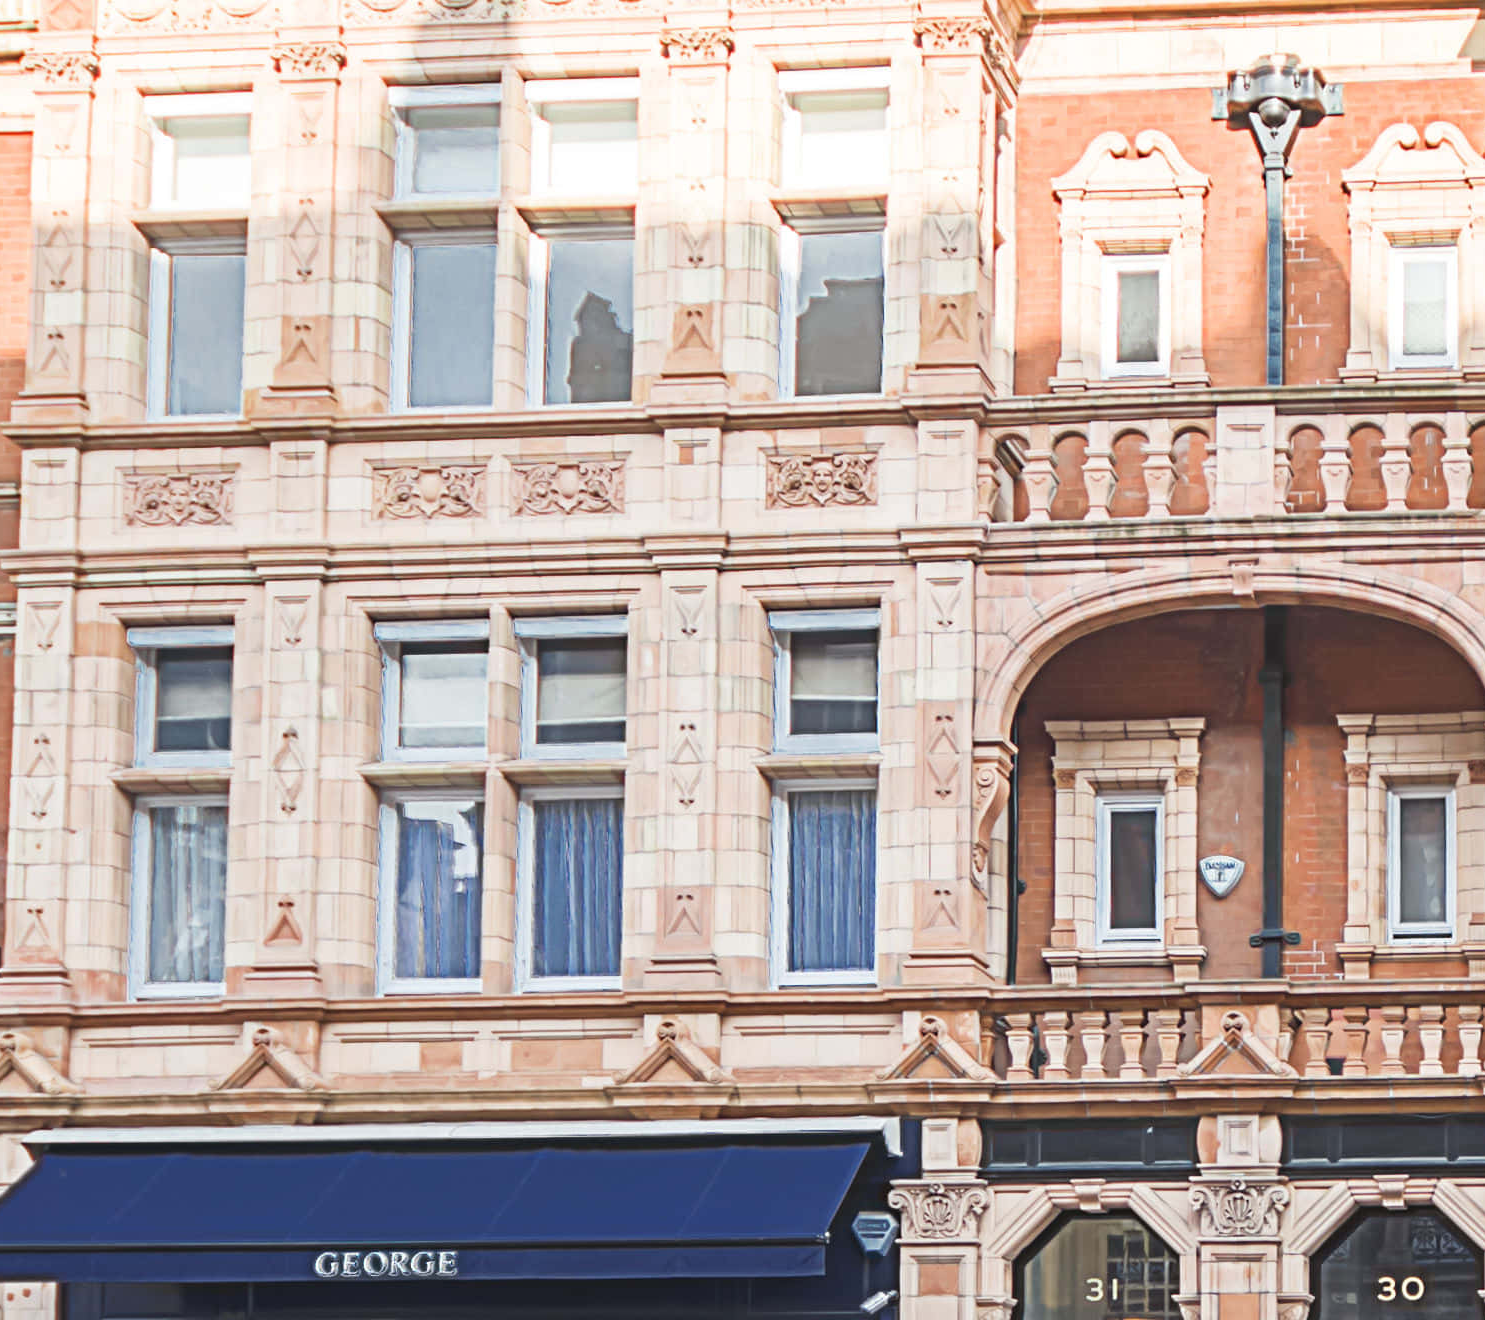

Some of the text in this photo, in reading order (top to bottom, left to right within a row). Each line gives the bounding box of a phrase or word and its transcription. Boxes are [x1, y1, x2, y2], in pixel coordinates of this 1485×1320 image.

[315, 1250, 459, 1278] GEORGE
[1086, 1278, 1118, 1301] 31
[1377, 1276, 1425, 1302] 30
